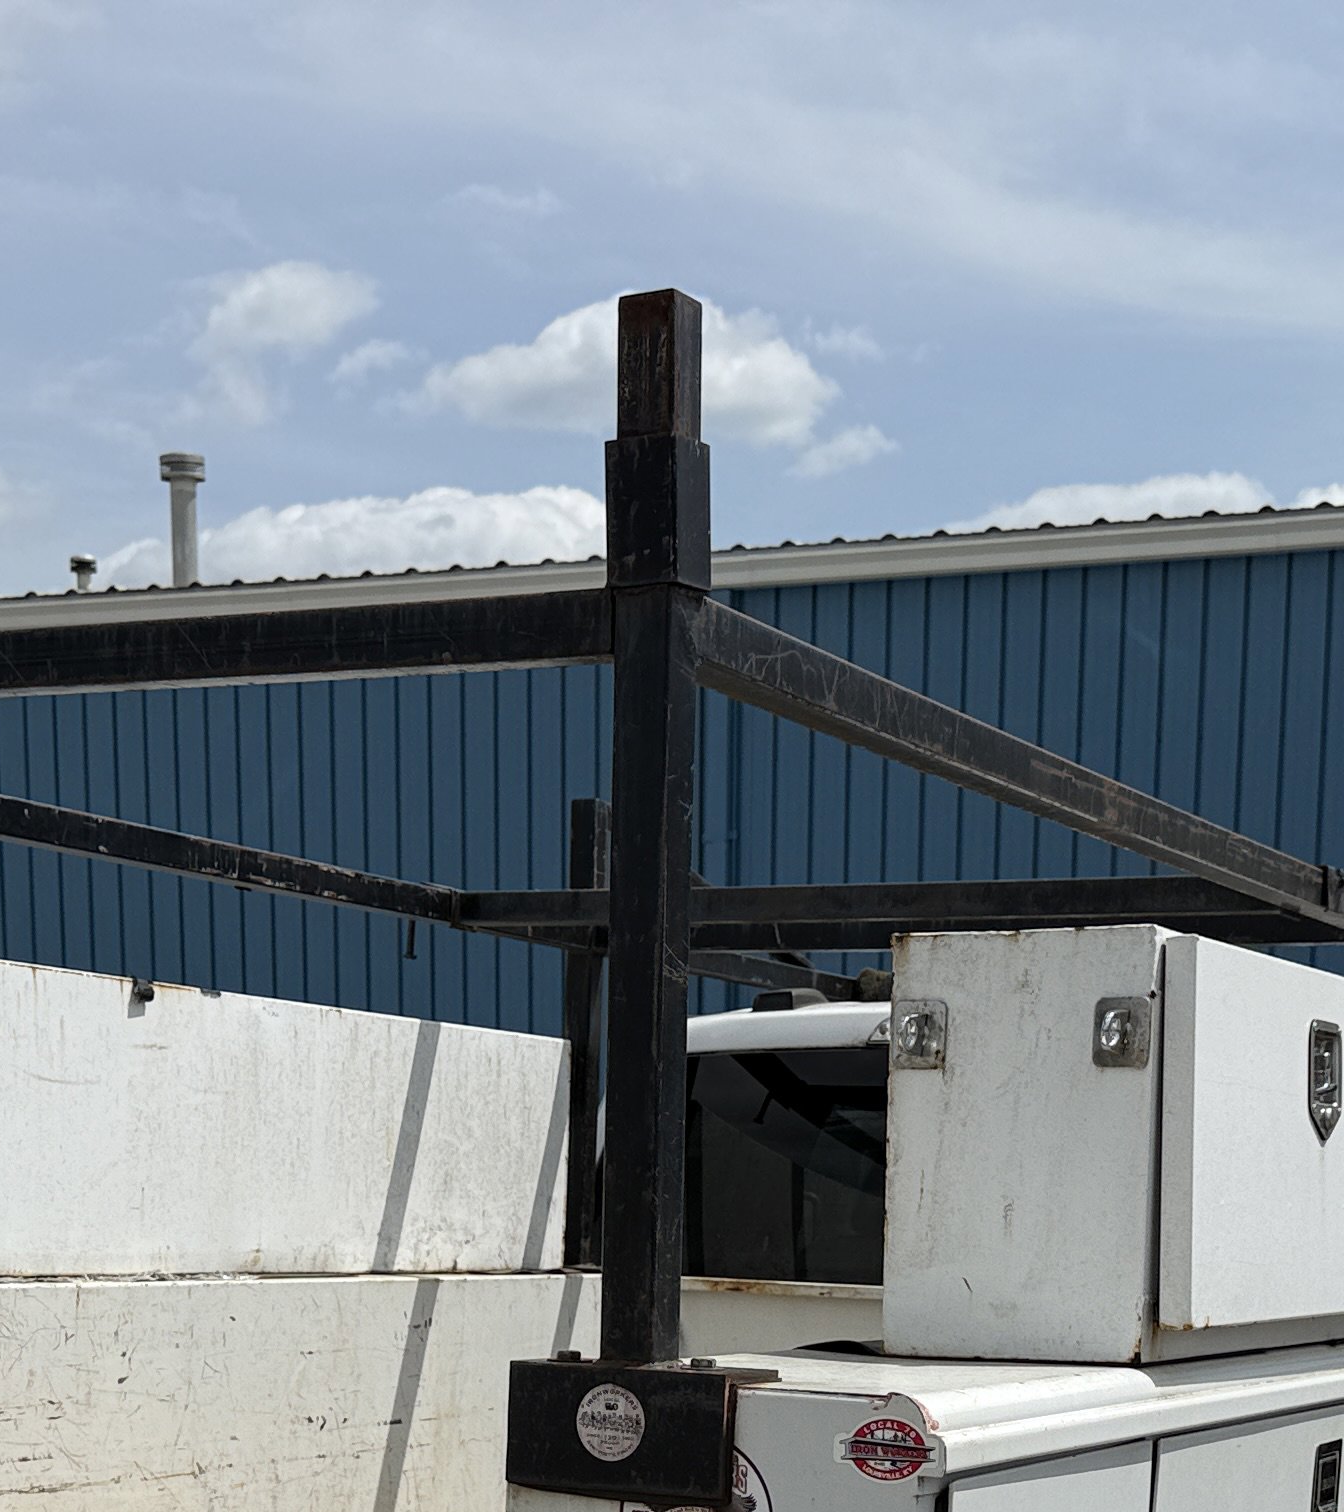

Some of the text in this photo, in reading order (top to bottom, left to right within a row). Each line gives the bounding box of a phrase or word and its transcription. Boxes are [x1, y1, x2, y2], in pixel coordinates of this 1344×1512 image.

[863, 1421, 917, 1438] LOCAL 70
[902, 1465, 914, 1477] KY
